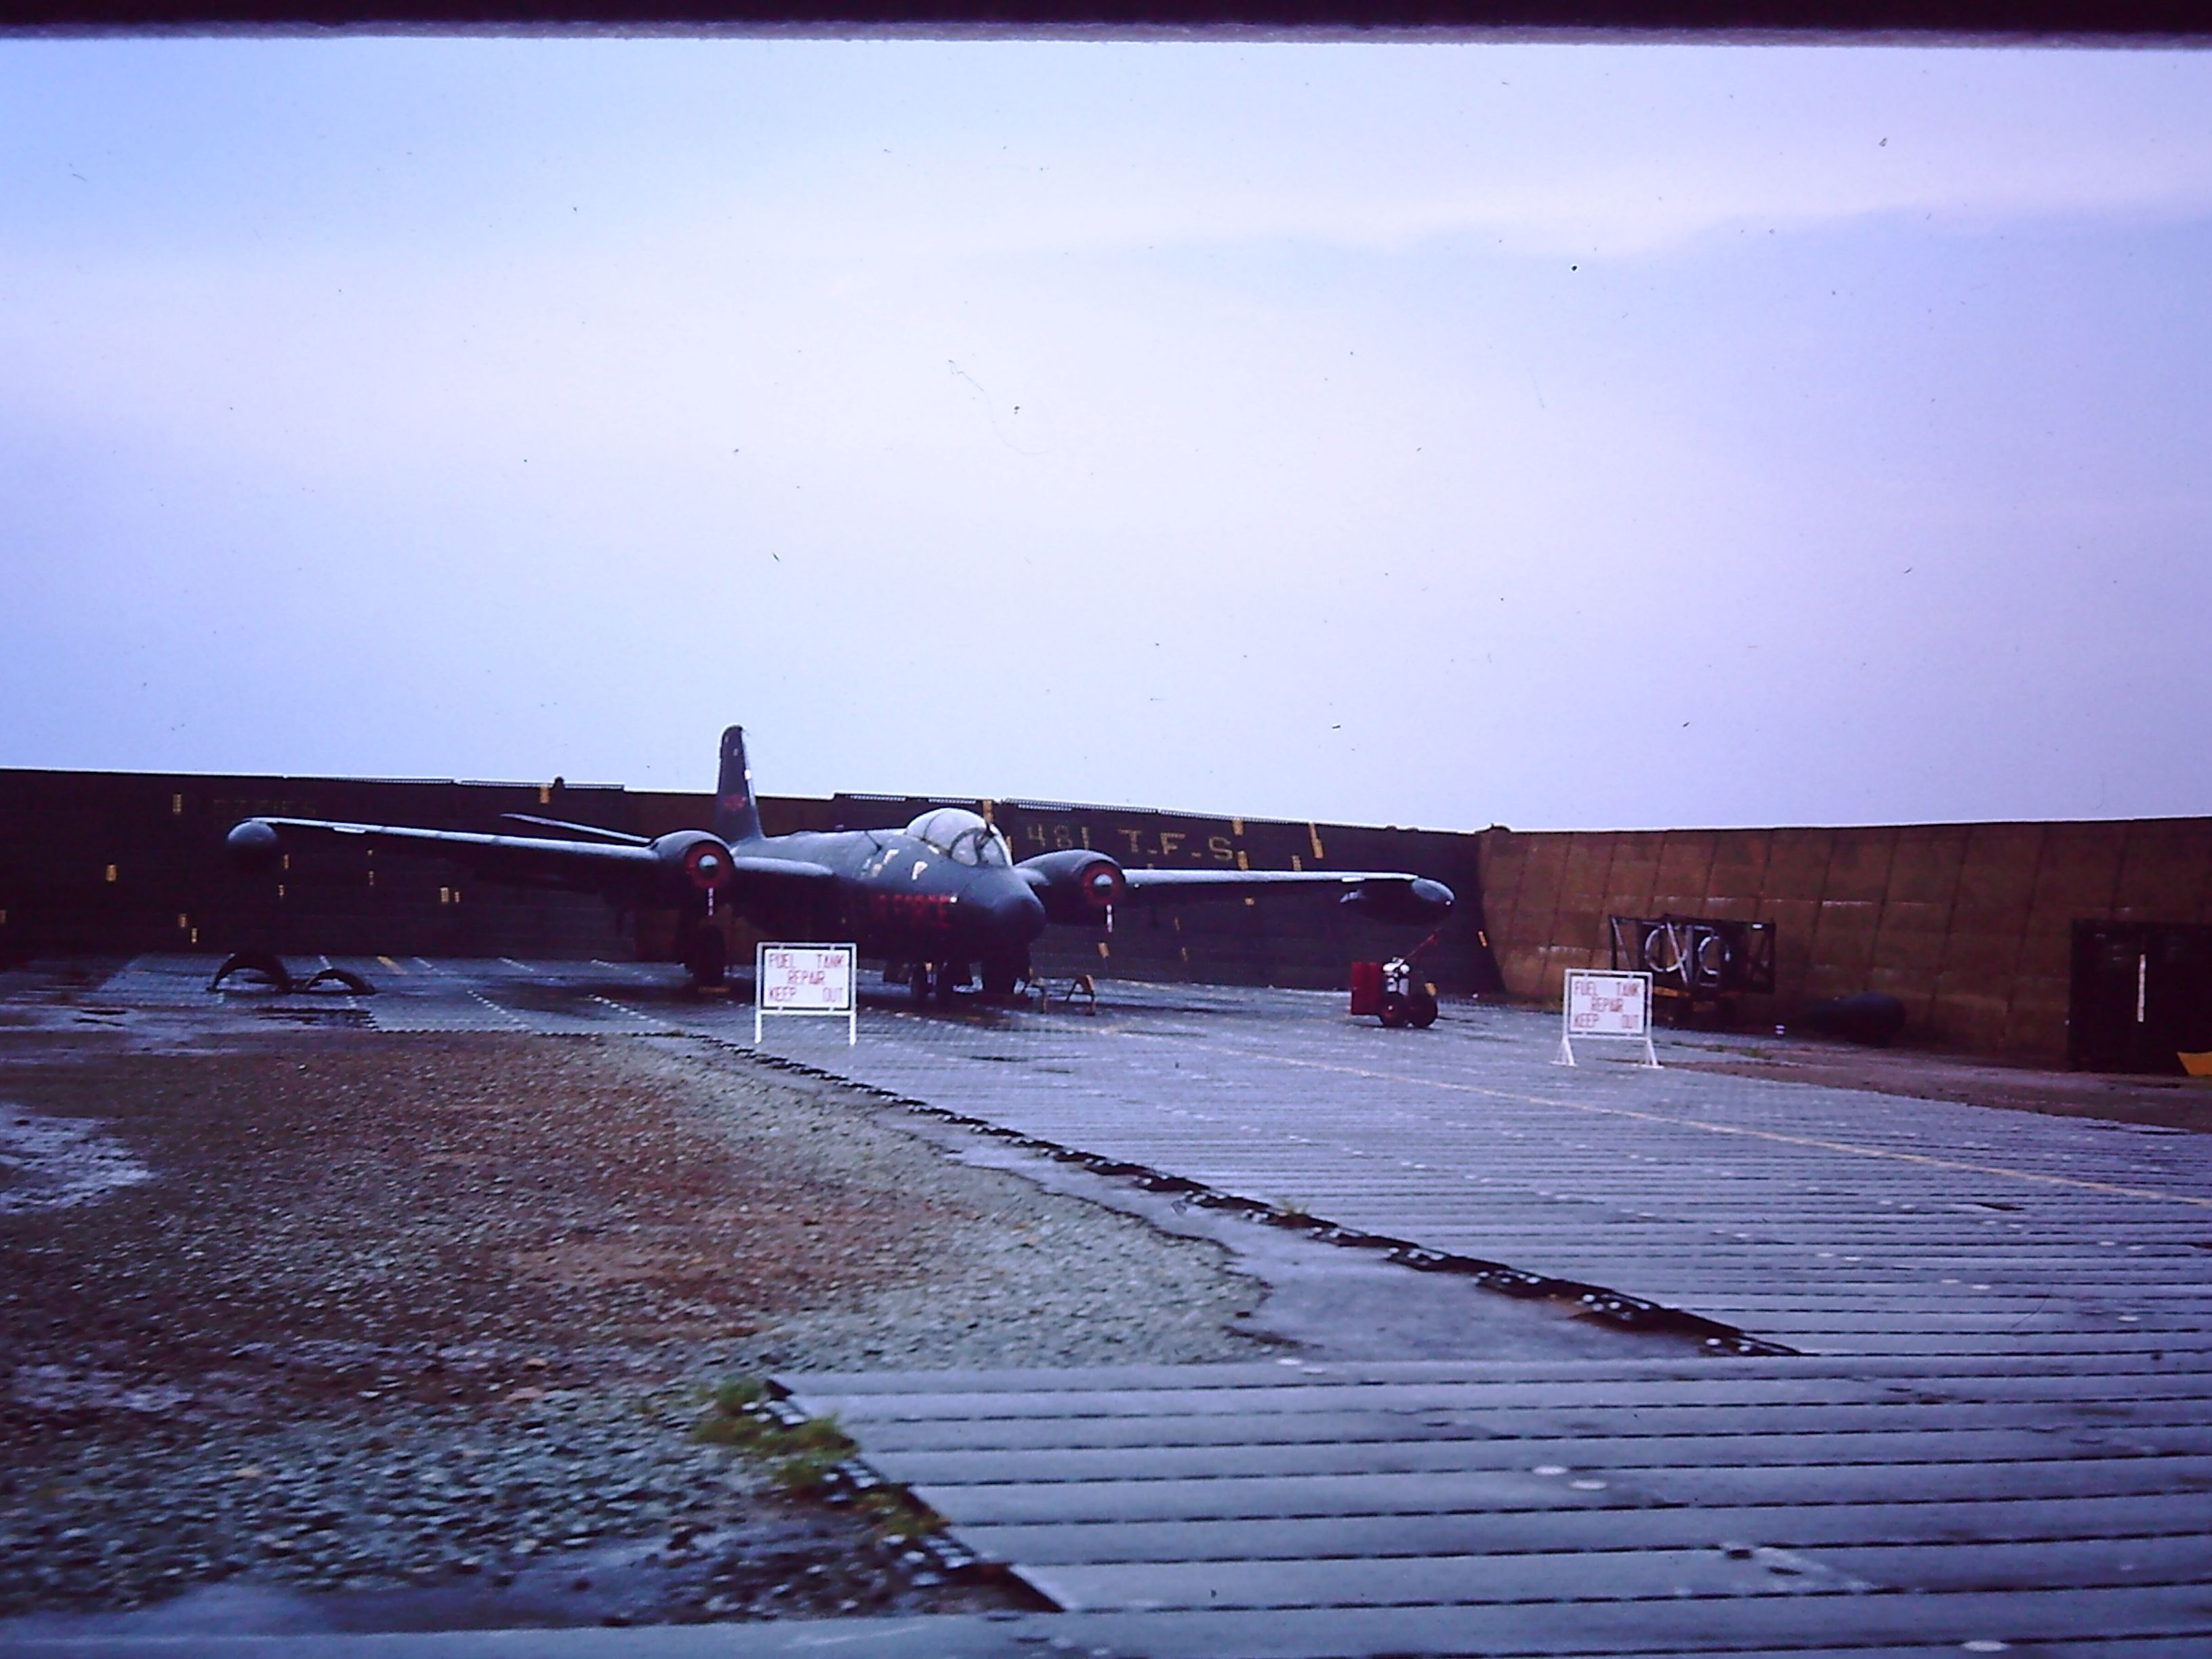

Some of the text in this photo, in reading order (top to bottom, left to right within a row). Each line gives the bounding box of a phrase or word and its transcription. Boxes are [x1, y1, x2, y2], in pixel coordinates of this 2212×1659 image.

[1026, 823, 1092, 850] 481
[769, 953, 845, 969] FUEL TANK
[787, 969, 827, 985] REPAIR
[769, 985, 844, 1003] KEEP OUT
[1574, 981, 1641, 997] FUEL TANK
[1591, 996, 1624, 1012] REPAIR
[1574, 1012, 1639, 1029] KEEP OUT
